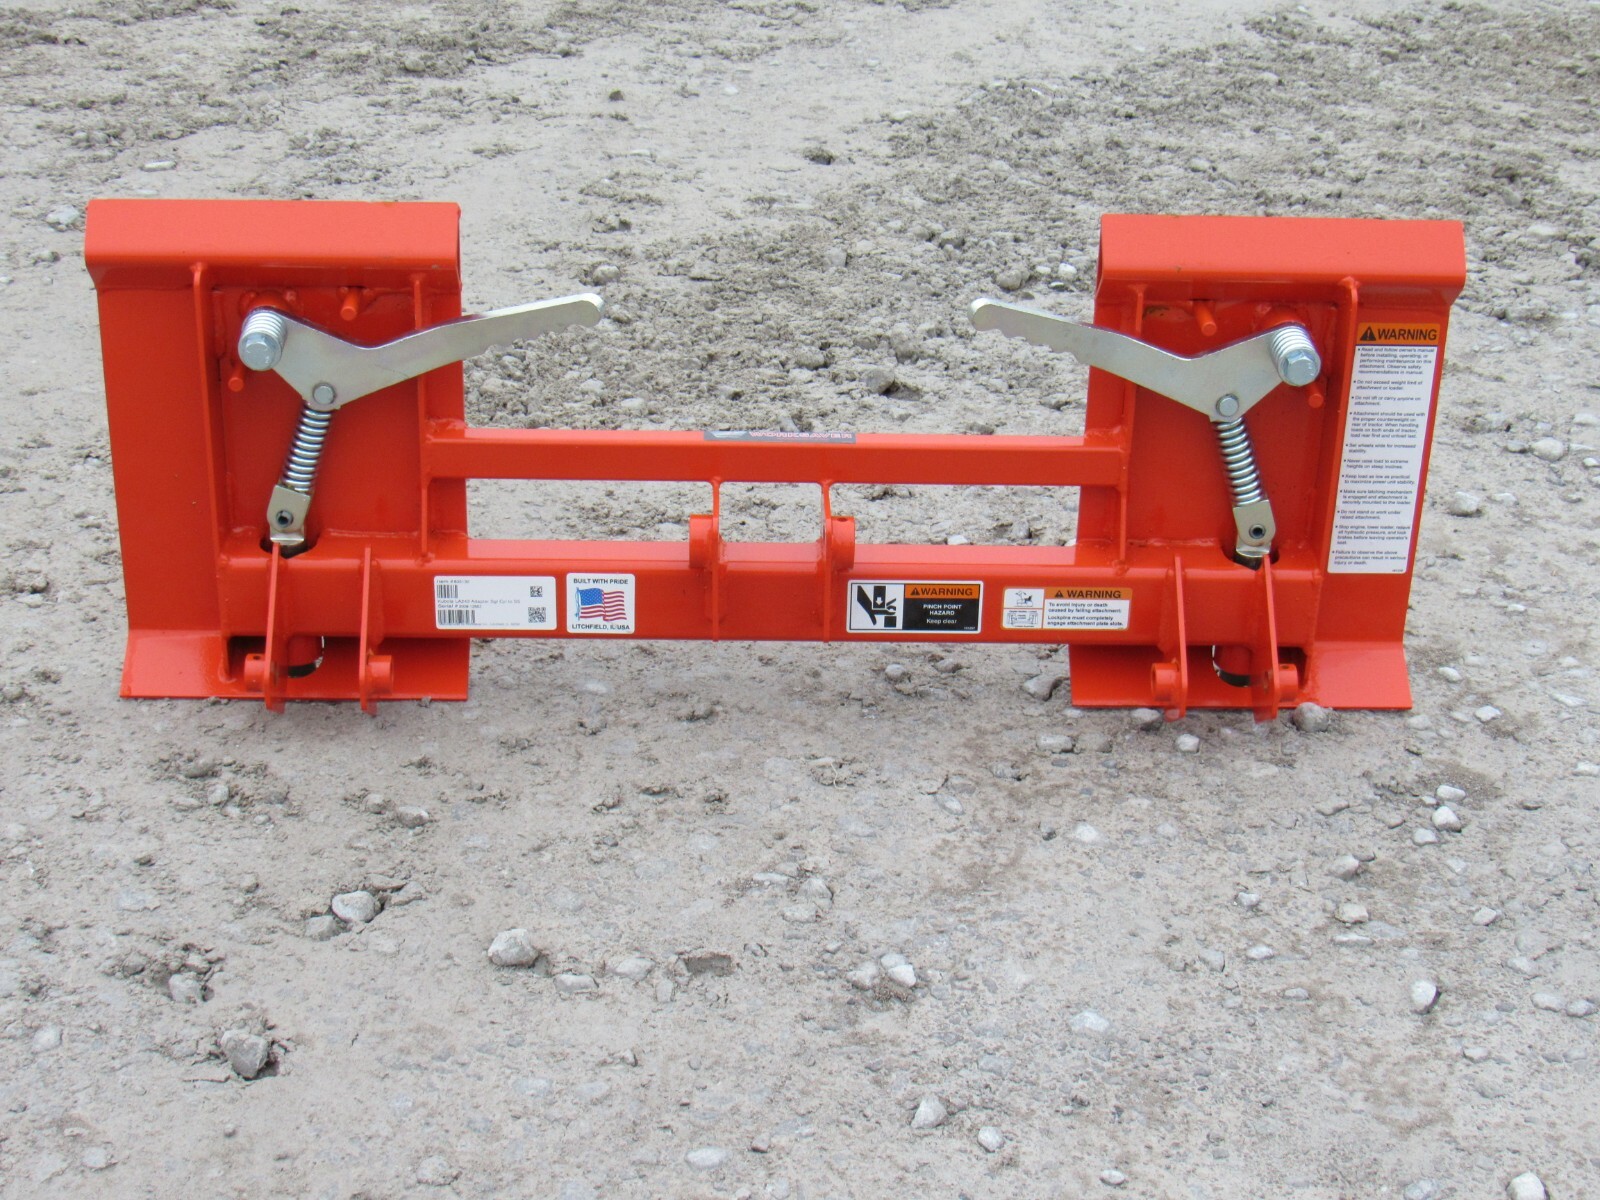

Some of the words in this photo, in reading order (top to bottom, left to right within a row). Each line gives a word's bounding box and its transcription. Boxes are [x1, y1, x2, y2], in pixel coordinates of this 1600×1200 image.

[1378, 329, 1437, 340] WARNING
[921, 588, 972, 596] WARNING
[1067, 590, 1121, 599] WARNING
